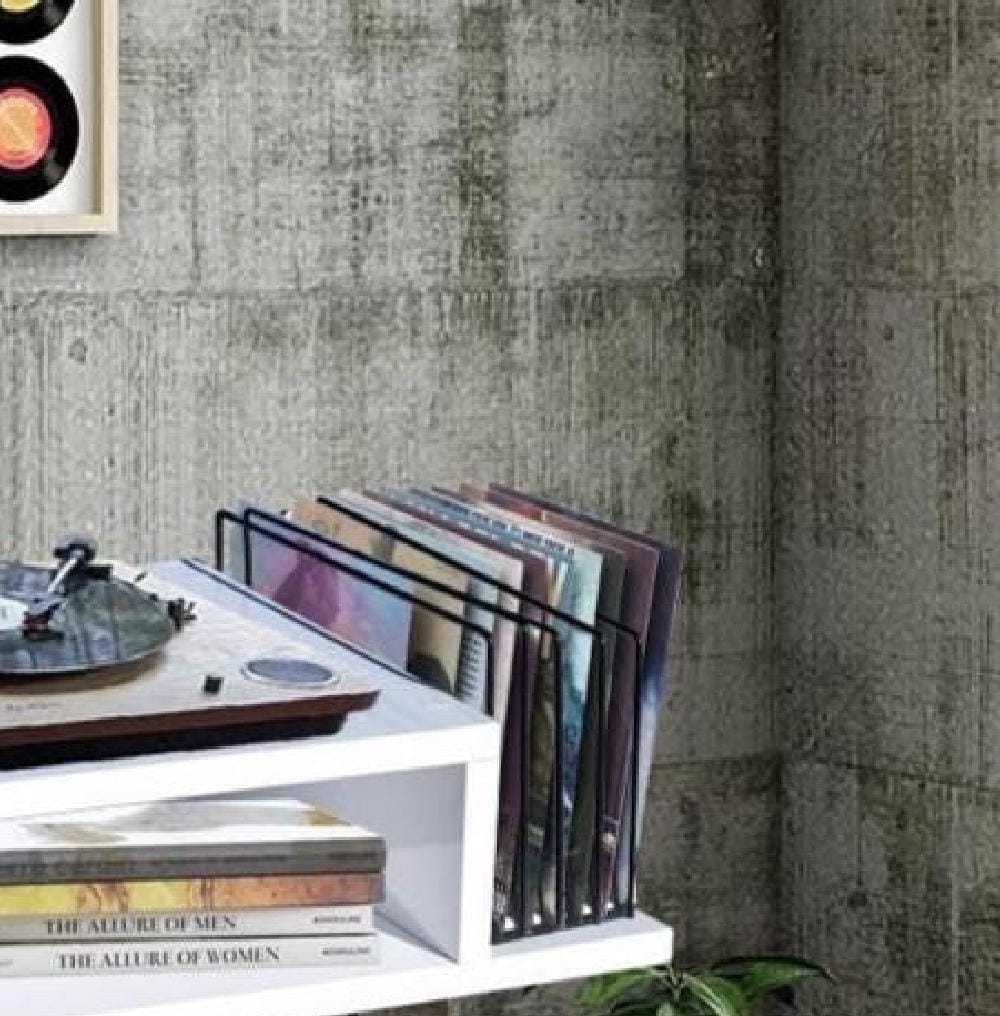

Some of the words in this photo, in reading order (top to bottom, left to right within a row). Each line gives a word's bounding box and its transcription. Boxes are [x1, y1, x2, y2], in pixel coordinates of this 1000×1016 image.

[44, 917, 80, 935] THE
[88, 917, 158, 934] ALLURE
[165, 916, 187, 932] OF
[194, 915, 239, 931] MEN
[58, 953, 93, 969] THE
[102, 951, 170, 967] ALLURE
[177, 950, 199, 965] OF
[206, 946, 281, 964] WOMEN
